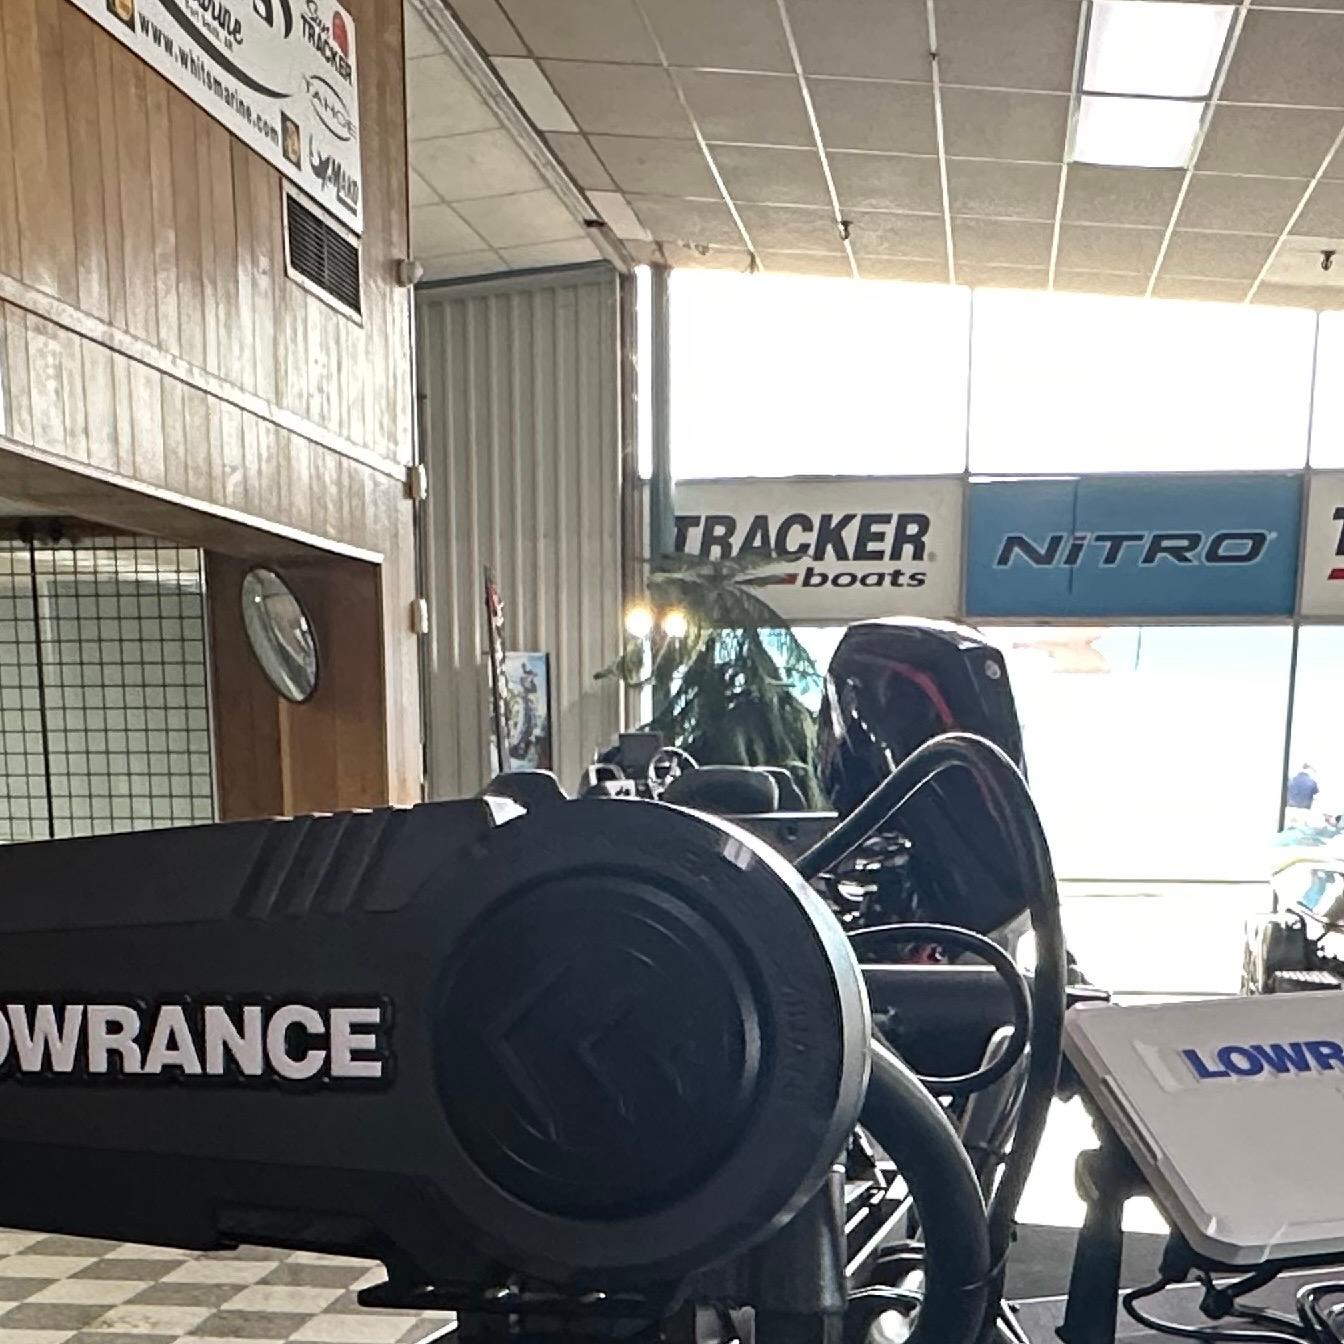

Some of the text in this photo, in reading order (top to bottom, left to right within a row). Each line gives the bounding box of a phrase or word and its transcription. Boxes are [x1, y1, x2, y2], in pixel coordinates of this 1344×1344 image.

[138, 11, 279, 146] www.whitsmarine.com
[301, 13, 352, 86] TRACKER
[674, 512, 931, 562] TRACKER
[801, 567, 927, 589] boats
